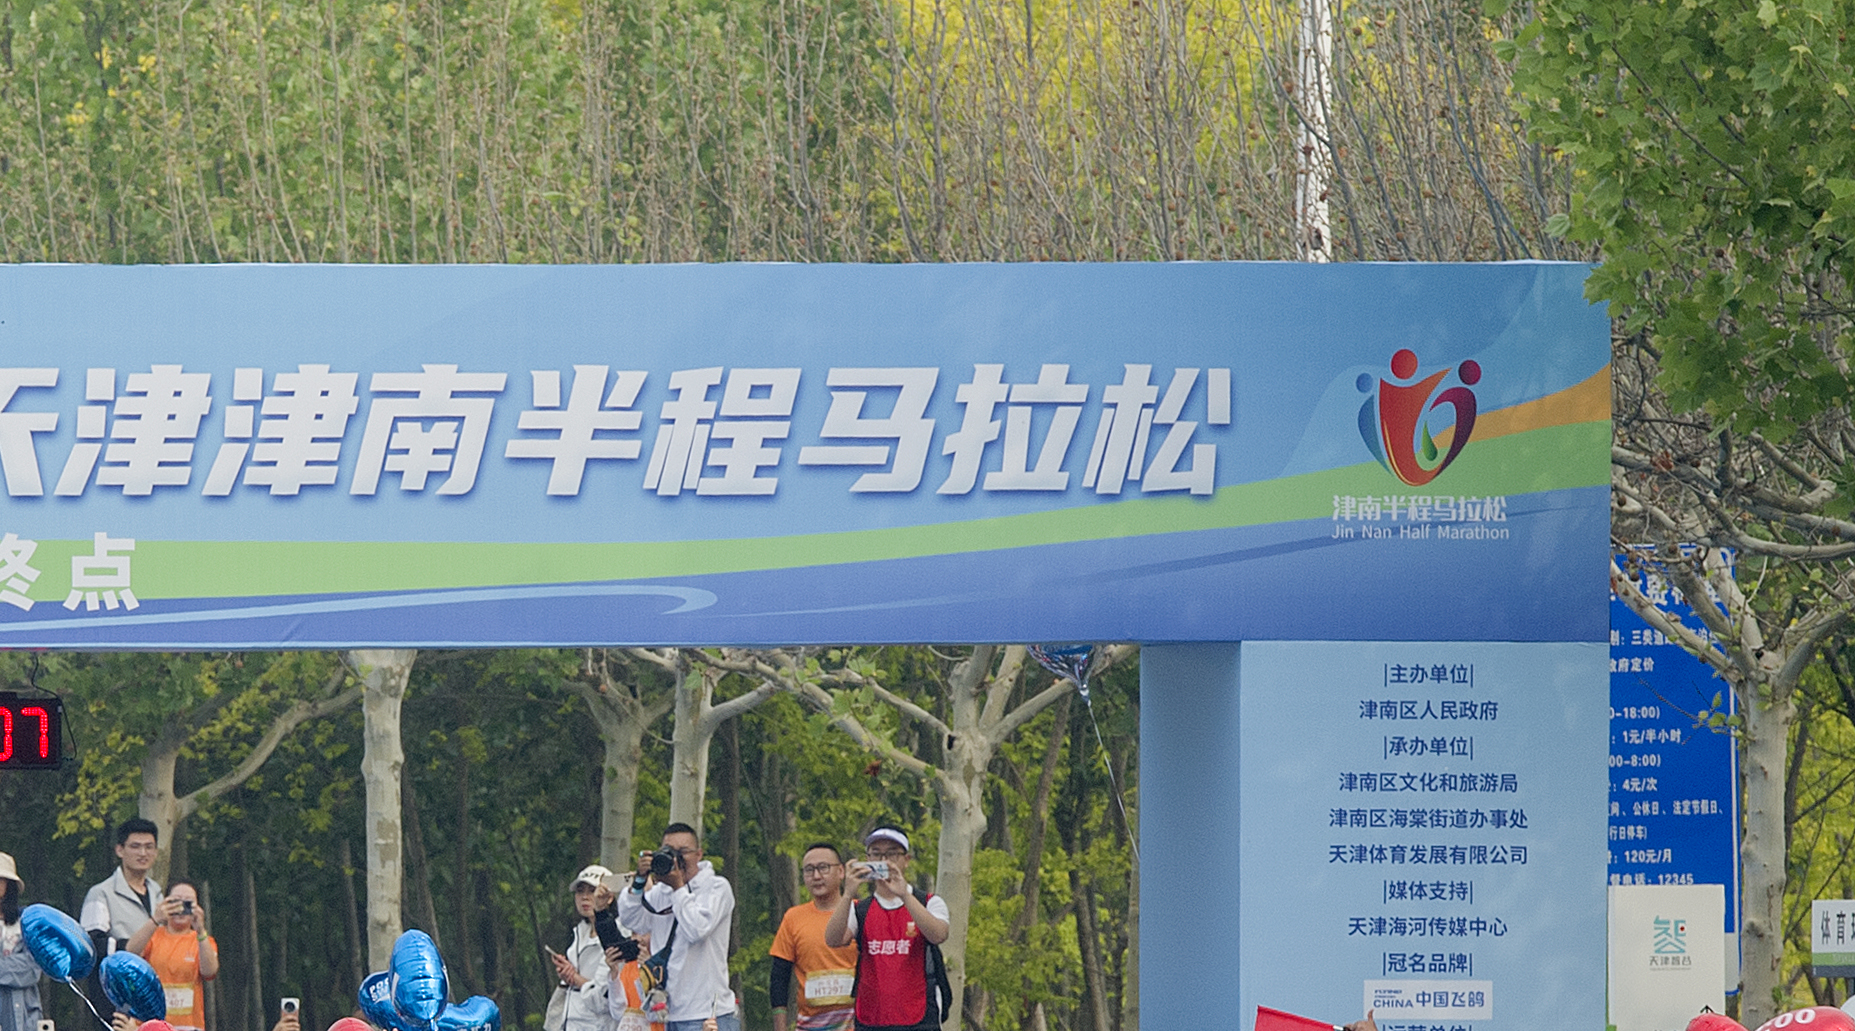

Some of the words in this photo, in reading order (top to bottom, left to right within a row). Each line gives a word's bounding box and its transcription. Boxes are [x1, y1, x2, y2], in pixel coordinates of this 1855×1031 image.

[1332, 495, 1507, 522] 津南半程马拉松
[1331, 524, 1354, 540] Jin
[1361, 524, 1392, 540] Nan
[1399, 524, 1430, 540] Half
[1438, 524, 1510, 540] Marathon
[1358, 700, 1499, 721] 津南区人民政府
[1339, 772, 1519, 793] 津南区文化和旅游局
[1329, 808, 1529, 829] 津南区海棠街道办事处
[1329, 844, 1529, 865] 天津体育发展有限公司
[1347, 916, 1509, 938] 天津海河传媒中心
[867, 940, 912, 956] 志愿者
[1373, 999, 1414, 1009] CHINA
[1415, 990, 1485, 1009] 中国飞鸽
